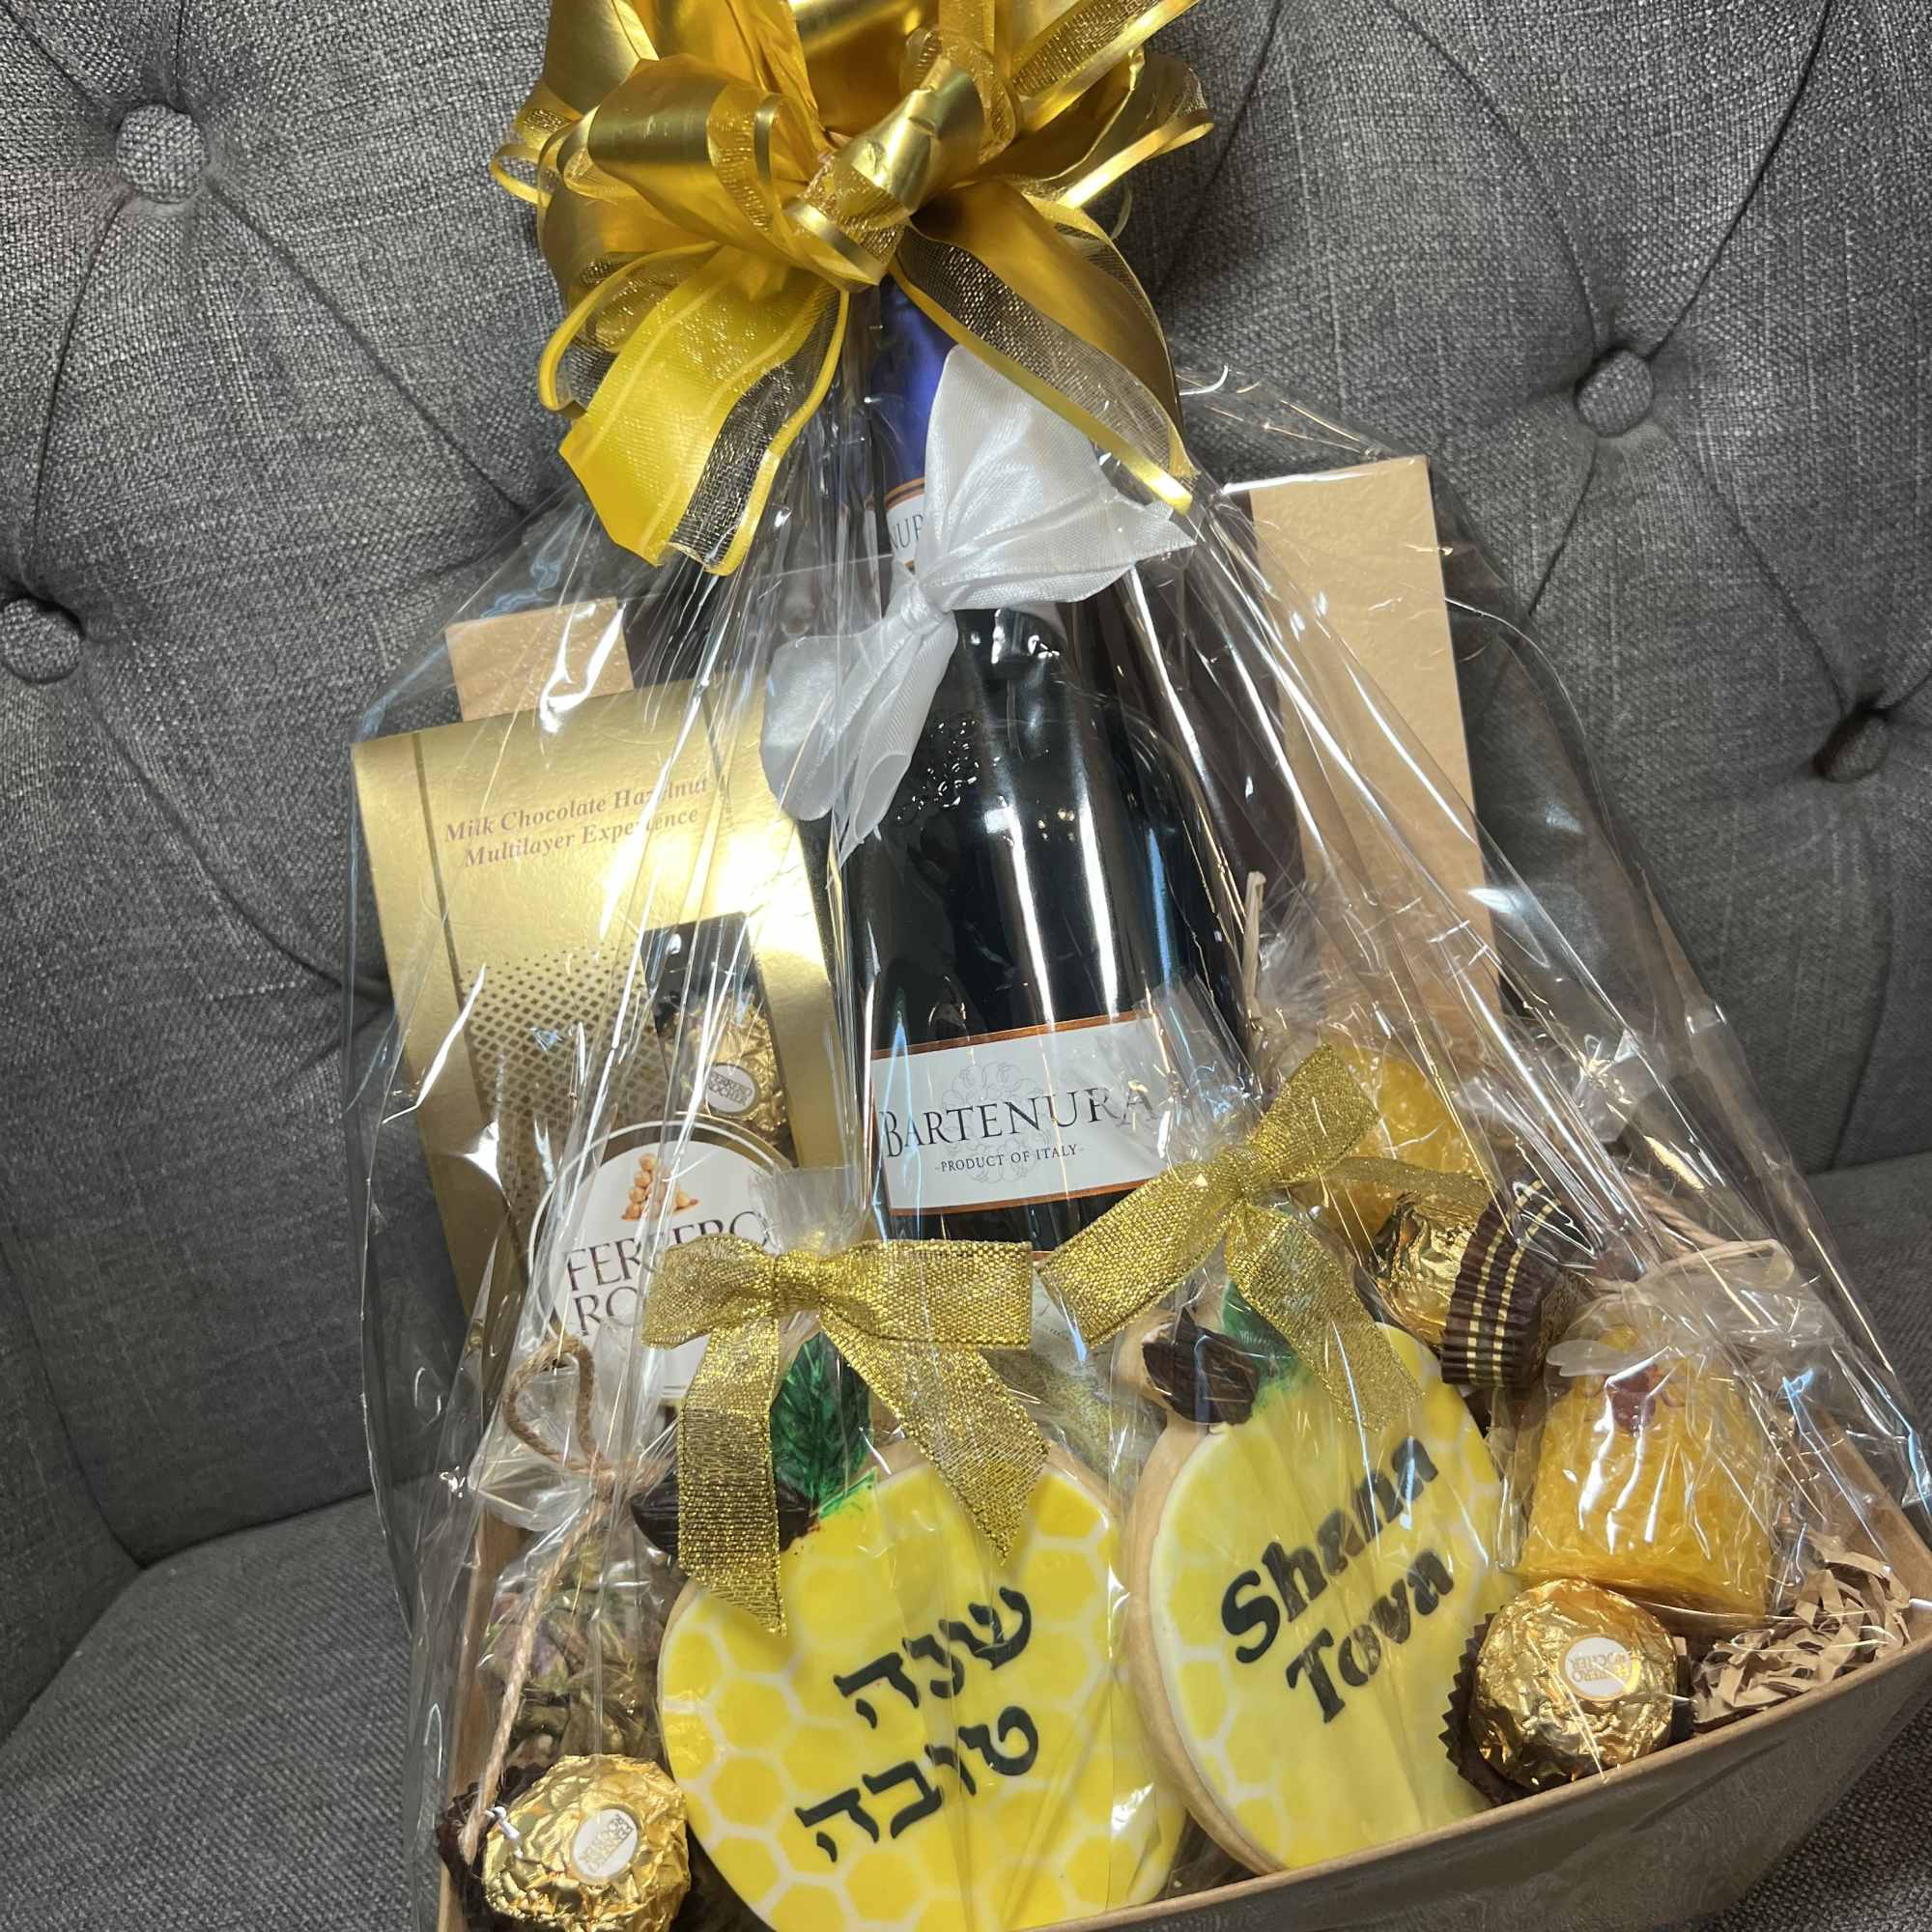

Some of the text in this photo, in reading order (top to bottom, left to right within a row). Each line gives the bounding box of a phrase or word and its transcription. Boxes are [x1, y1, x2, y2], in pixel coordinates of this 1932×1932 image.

[444, 816, 494, 842] Milk
[499, 797, 607, 832] Chocolate
[465, 832, 576, 867] Multilayer
[880, 1086, 1159, 1159] BARTENURA
[941, 1143, 1079, 1172] PRODUCT OF ITALY
[1221, 1436, 1438, 1663] Shana
[833, 1586, 1032, 1729] שנה
[1286, 1548, 1454, 1723] Tova
[794, 1705, 1038, 1862] טובה
